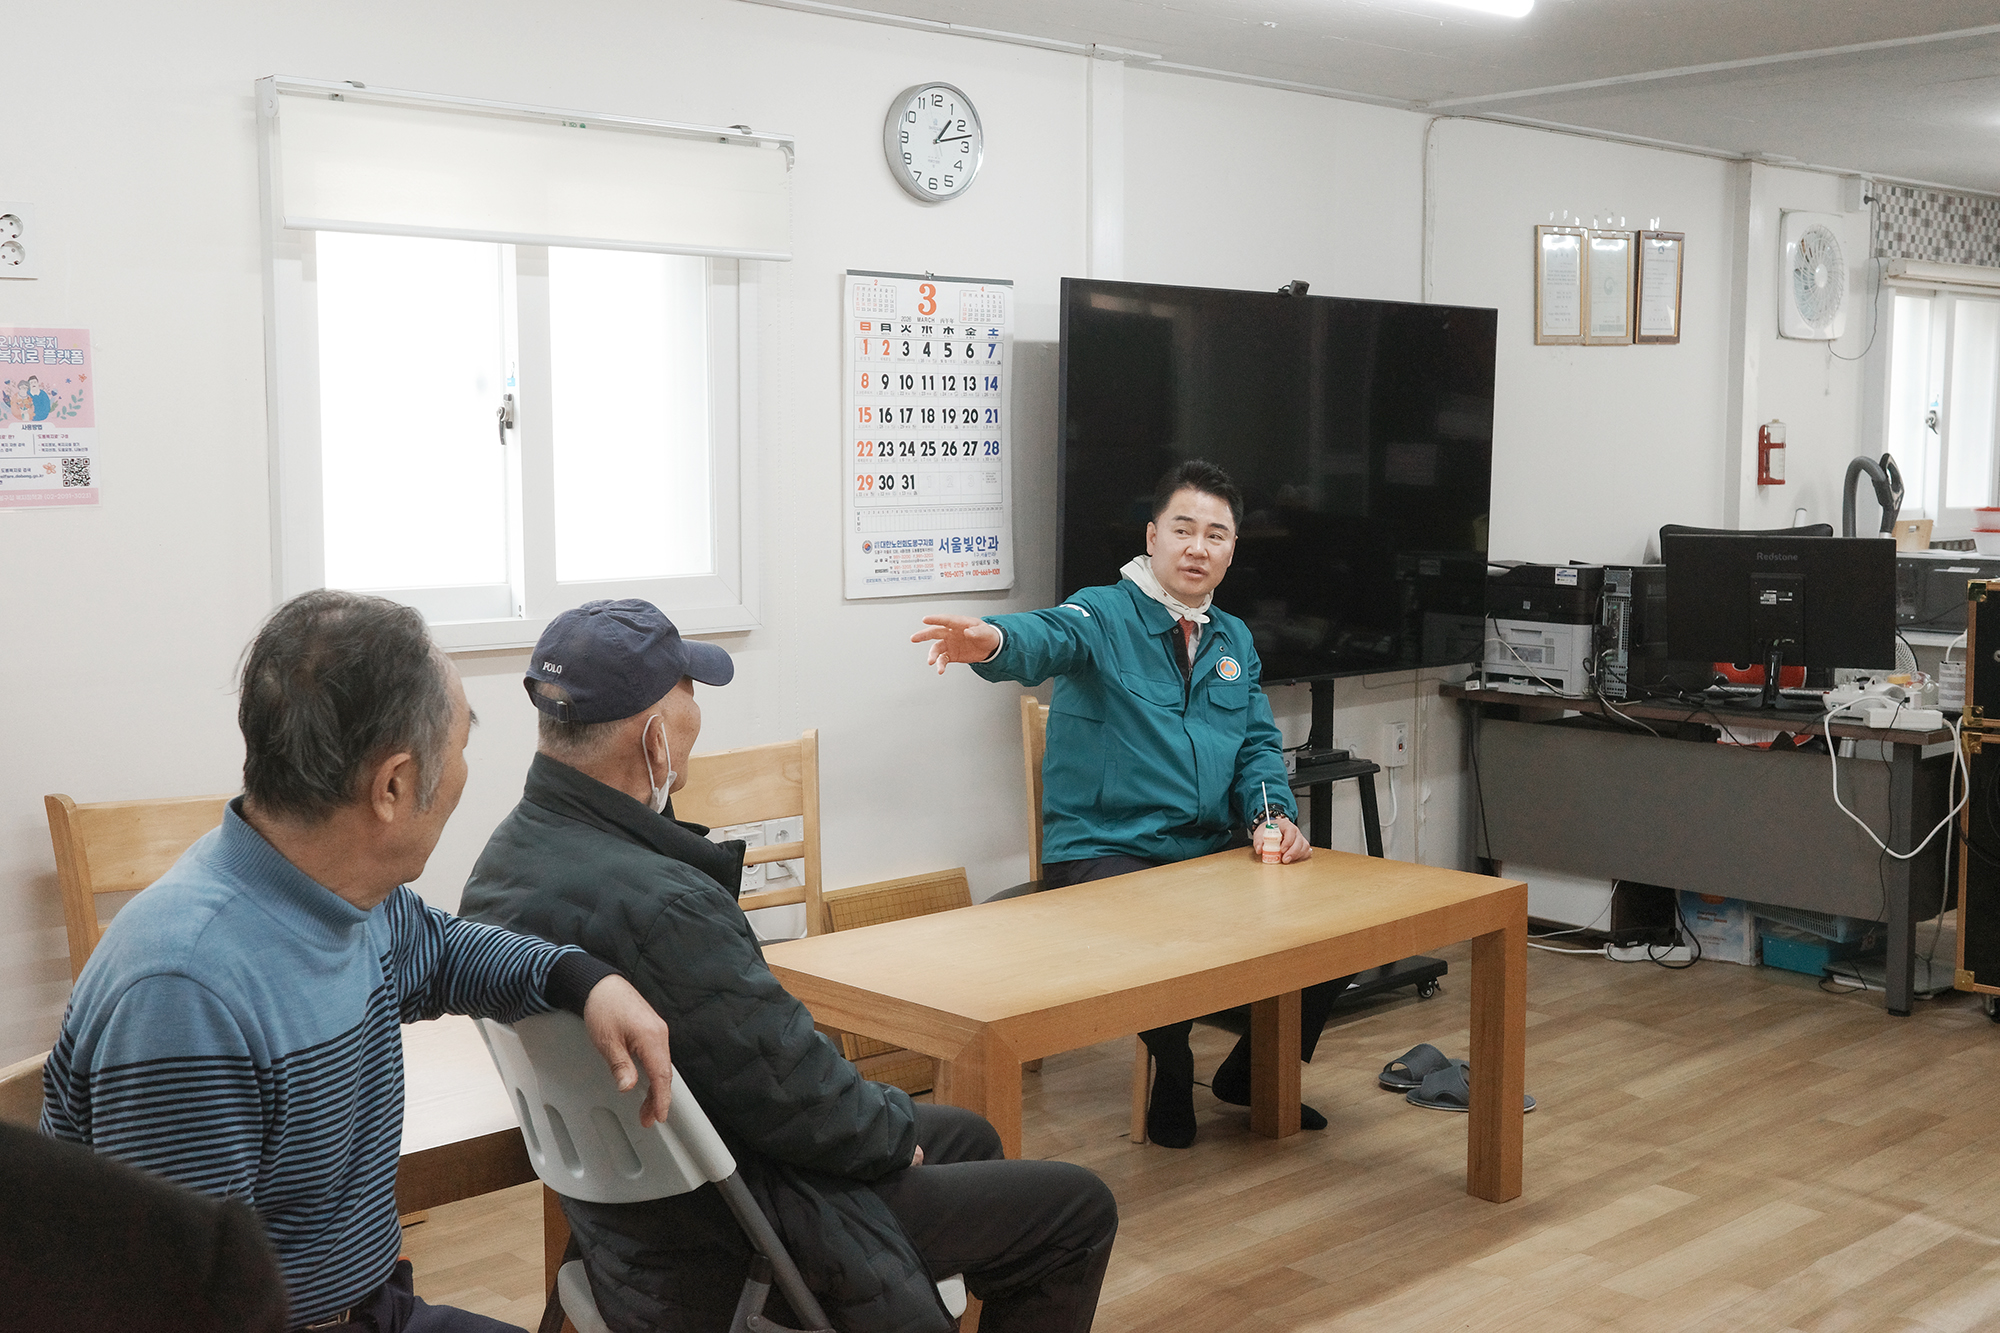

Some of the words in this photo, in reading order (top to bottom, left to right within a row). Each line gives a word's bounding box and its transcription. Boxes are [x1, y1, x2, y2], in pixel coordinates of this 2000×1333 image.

[918, 97, 925, 109] 11
[931, 94, 943, 107] 12
[957, 120, 966, 132] 2
[961, 141, 969, 153] 3
[954, 160, 963, 172] 4
[913, 171, 922, 182] 7
[944, 175, 953, 187] 5
[928, 178, 938, 190] 6
[918, 284, 937, 315] 3
[901, 325, 912, 333] 火
[921, 326, 933, 334] 水
[943, 326, 954, 335] 木
[965, 327, 976, 336] 金
[988, 328, 999, 336] 土
[863, 339, 868, 355] 1
[883, 340, 890, 355] 2
[903, 341, 910, 356] 3
[923, 342, 931, 357] 4
[944, 343, 952, 358] 5
[966, 343, 974, 358] 6
[988, 344, 996, 358] 7
[43, 350, 84, 365] 플랫폼
[861, 373, 869, 389] 8
[881, 374, 889, 389] 9
[900, 375, 913, 390] 10
[922, 375, 934, 390] 11
[942, 376, 956, 391] 12
[963, 376, 976, 391] 13
[985, 376, 998, 391] 14
[858, 407, 872, 423] 15
[879, 408, 892, 423] 16
[900, 408, 913, 423] 17
[921, 408, 935, 423] 18
[942, 409, 956, 423] 19
[962, 409, 978, 423] 20
[985, 409, 998, 423] 21
[857, 441, 873, 456] 22
[878, 441, 894, 456] 23
[899, 441, 915, 456] 24
[920, 441, 936, 456] 25
[942, 441, 958, 456] 26
[963, 441, 978, 456] 27
[984, 441, 999, 455] 28
[857, 475, 874, 490] 29
[879, 475, 894, 490] 30
[902, 475, 915, 489] 31
[939, 535, 999, 554] 서울빛안과
[1757, 552, 1798, 560] Redstone
[542, 662, 562, 674] POLO
